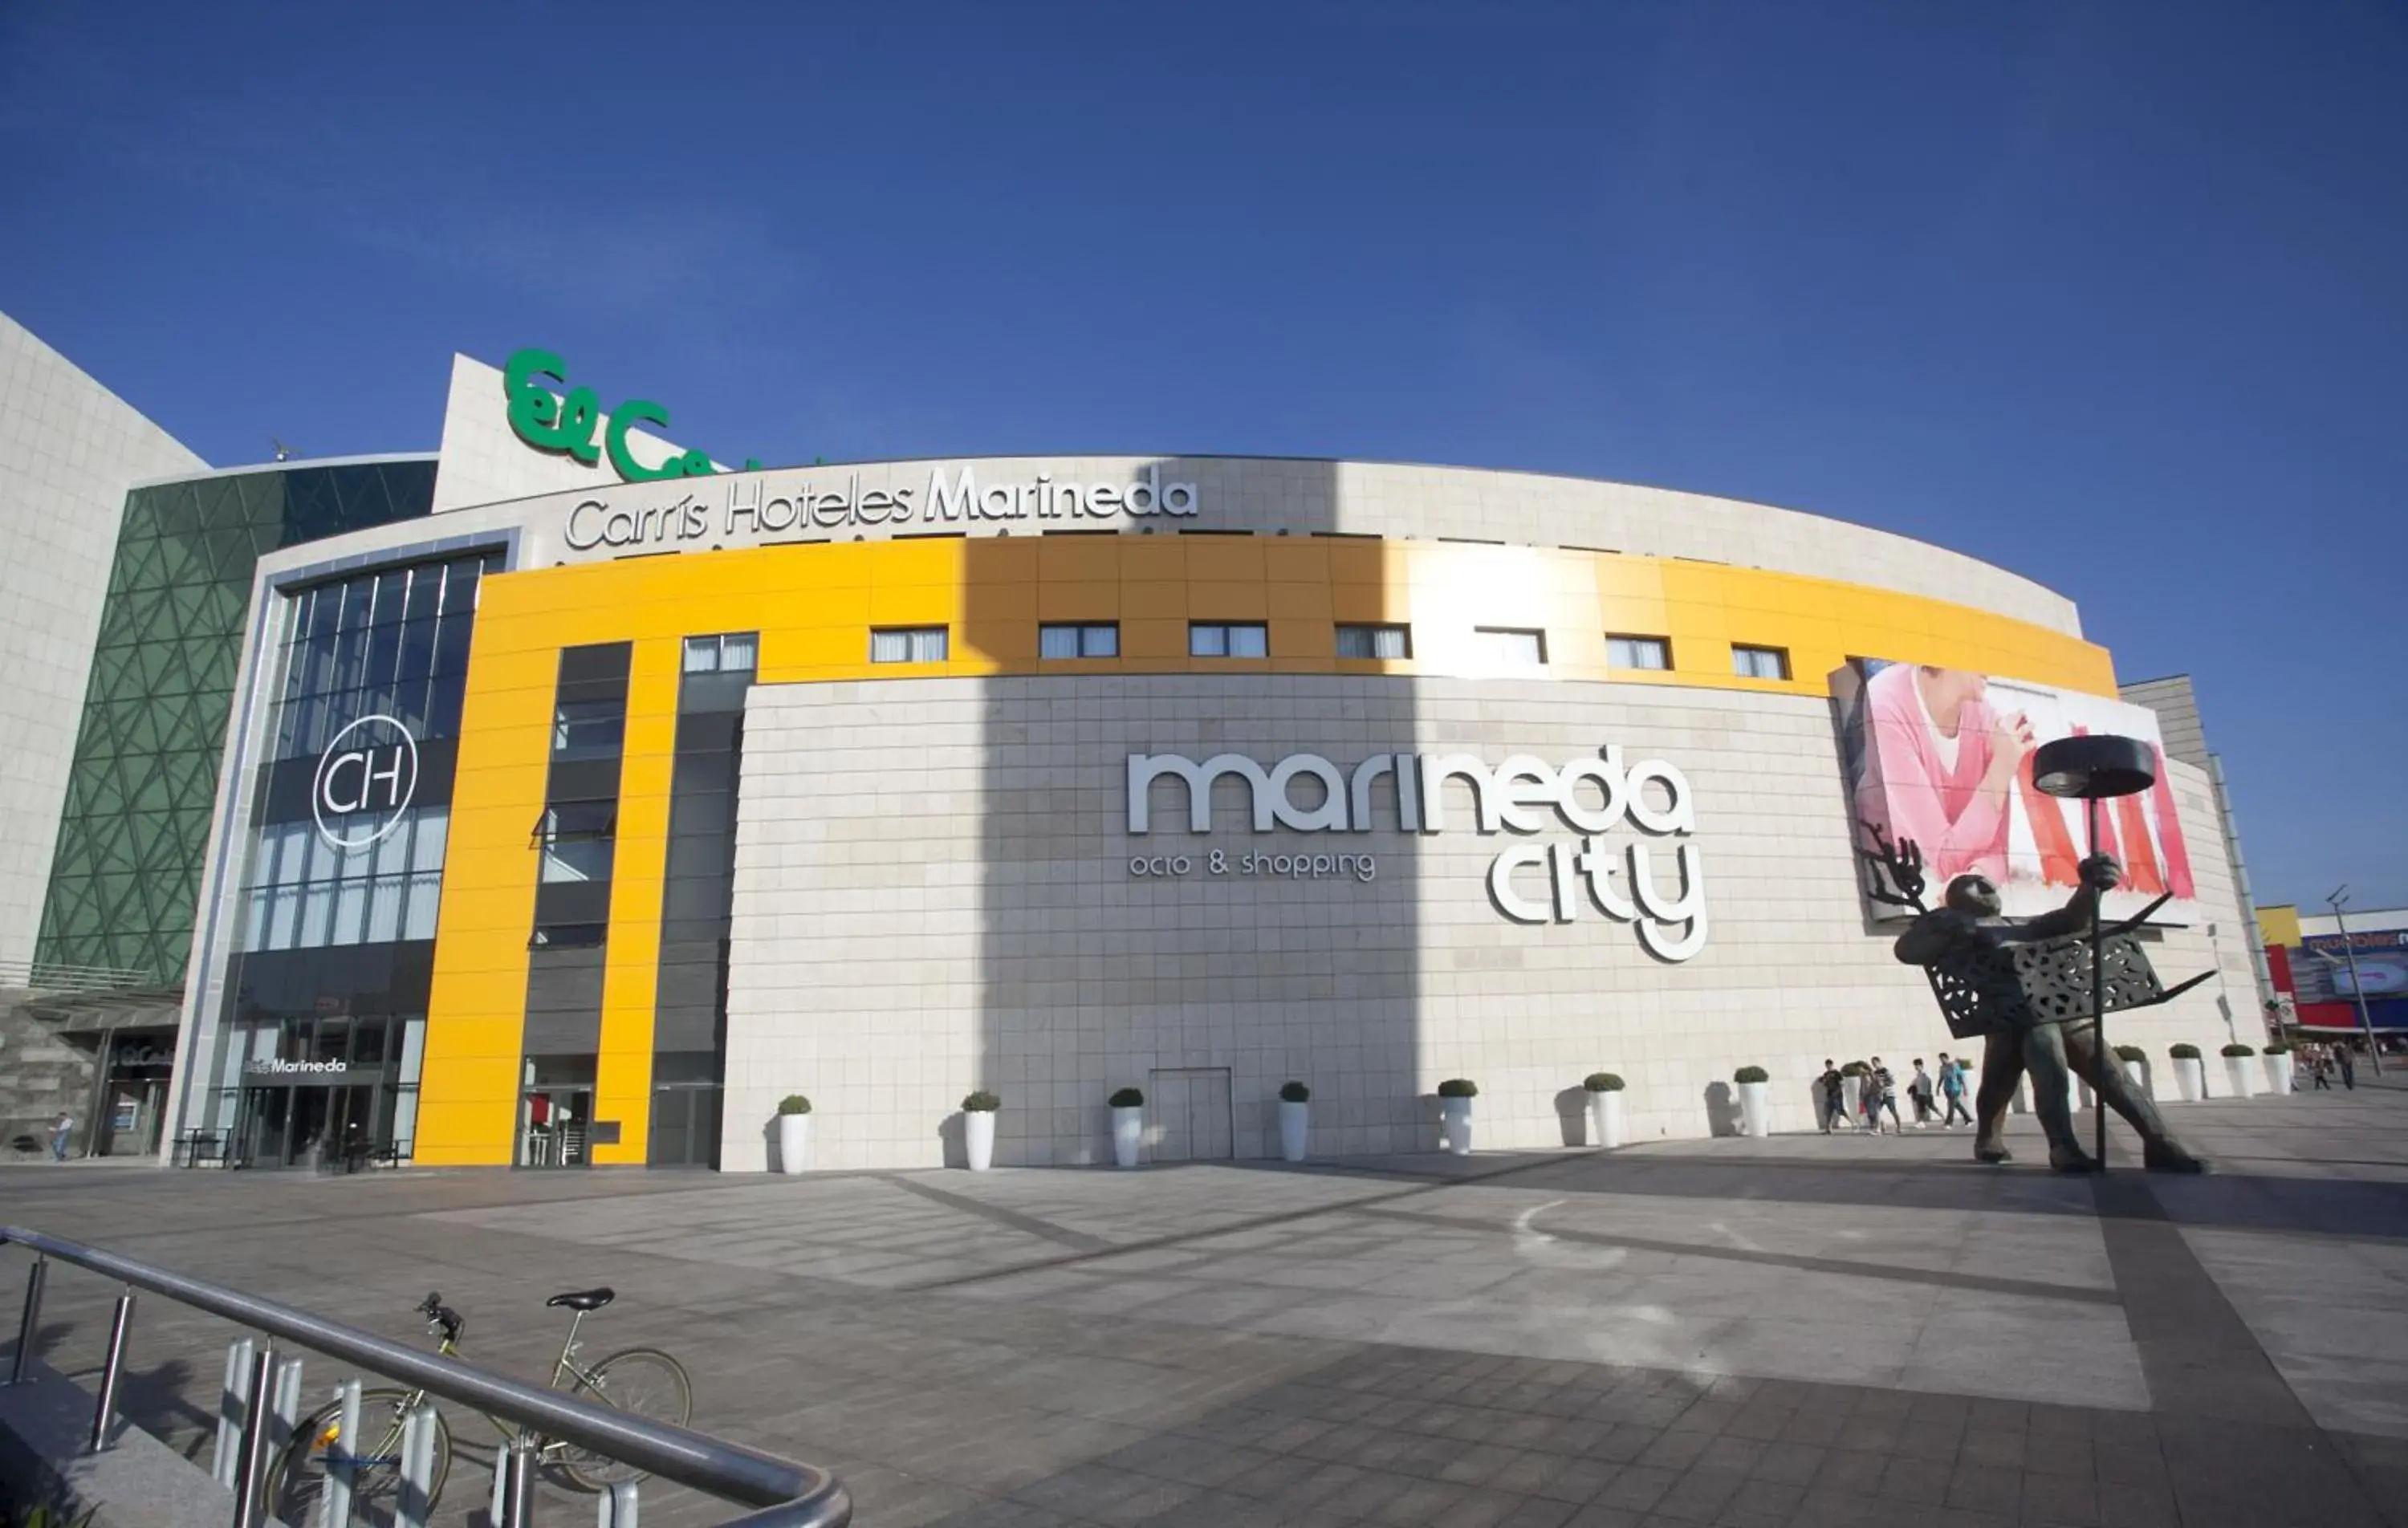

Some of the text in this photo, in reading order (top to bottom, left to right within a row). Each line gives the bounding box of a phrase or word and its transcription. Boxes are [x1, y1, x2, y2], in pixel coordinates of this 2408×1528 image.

[503, 347, 601, 468] El
[564, 465, 1198, 550] Carrís Hoteles Marineda
[323, 745, 402, 813] CH
[1127, 745, 1694, 836] marineda
[1130, 848, 1376, 881] ocio & shopping
[1487, 835, 1708, 963] city
[271, 1057, 347, 1074] Marineda
